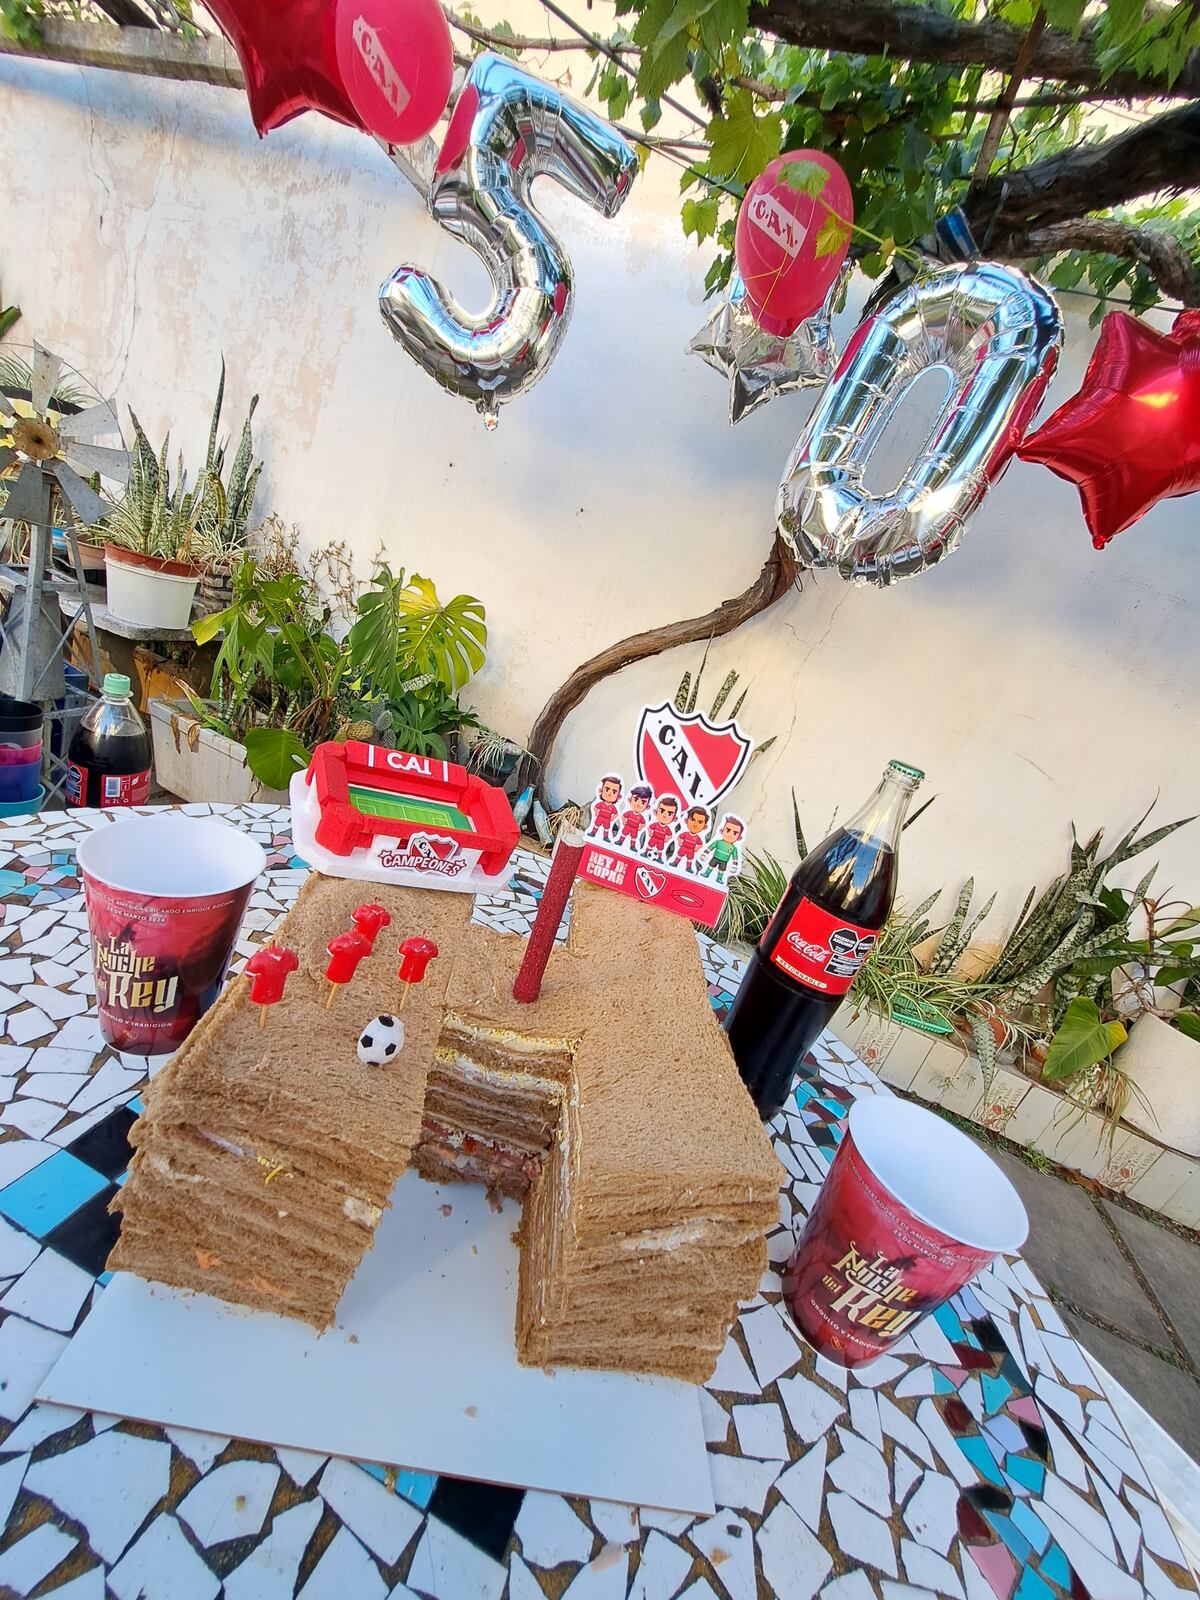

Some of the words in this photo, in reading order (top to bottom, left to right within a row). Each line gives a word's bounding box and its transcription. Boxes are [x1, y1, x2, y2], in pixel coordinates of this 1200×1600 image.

[387, 752, 432, 775] CAI
[383, 855, 461, 876] CAMPEONES
[589, 851, 614, 869] REY
[123, 911, 147, 920] MARZO
[108, 932, 130, 955] La
[94, 934, 156, 979] Noche
[101, 962, 179, 1013] Rey
[902, 1235, 912, 1245] DE
[913, 1243, 938, 1260] MARZO
[831, 1240, 919, 1304] Noche
[869, 1250, 902, 1280] La
[829, 1269, 922, 1338] Rey
